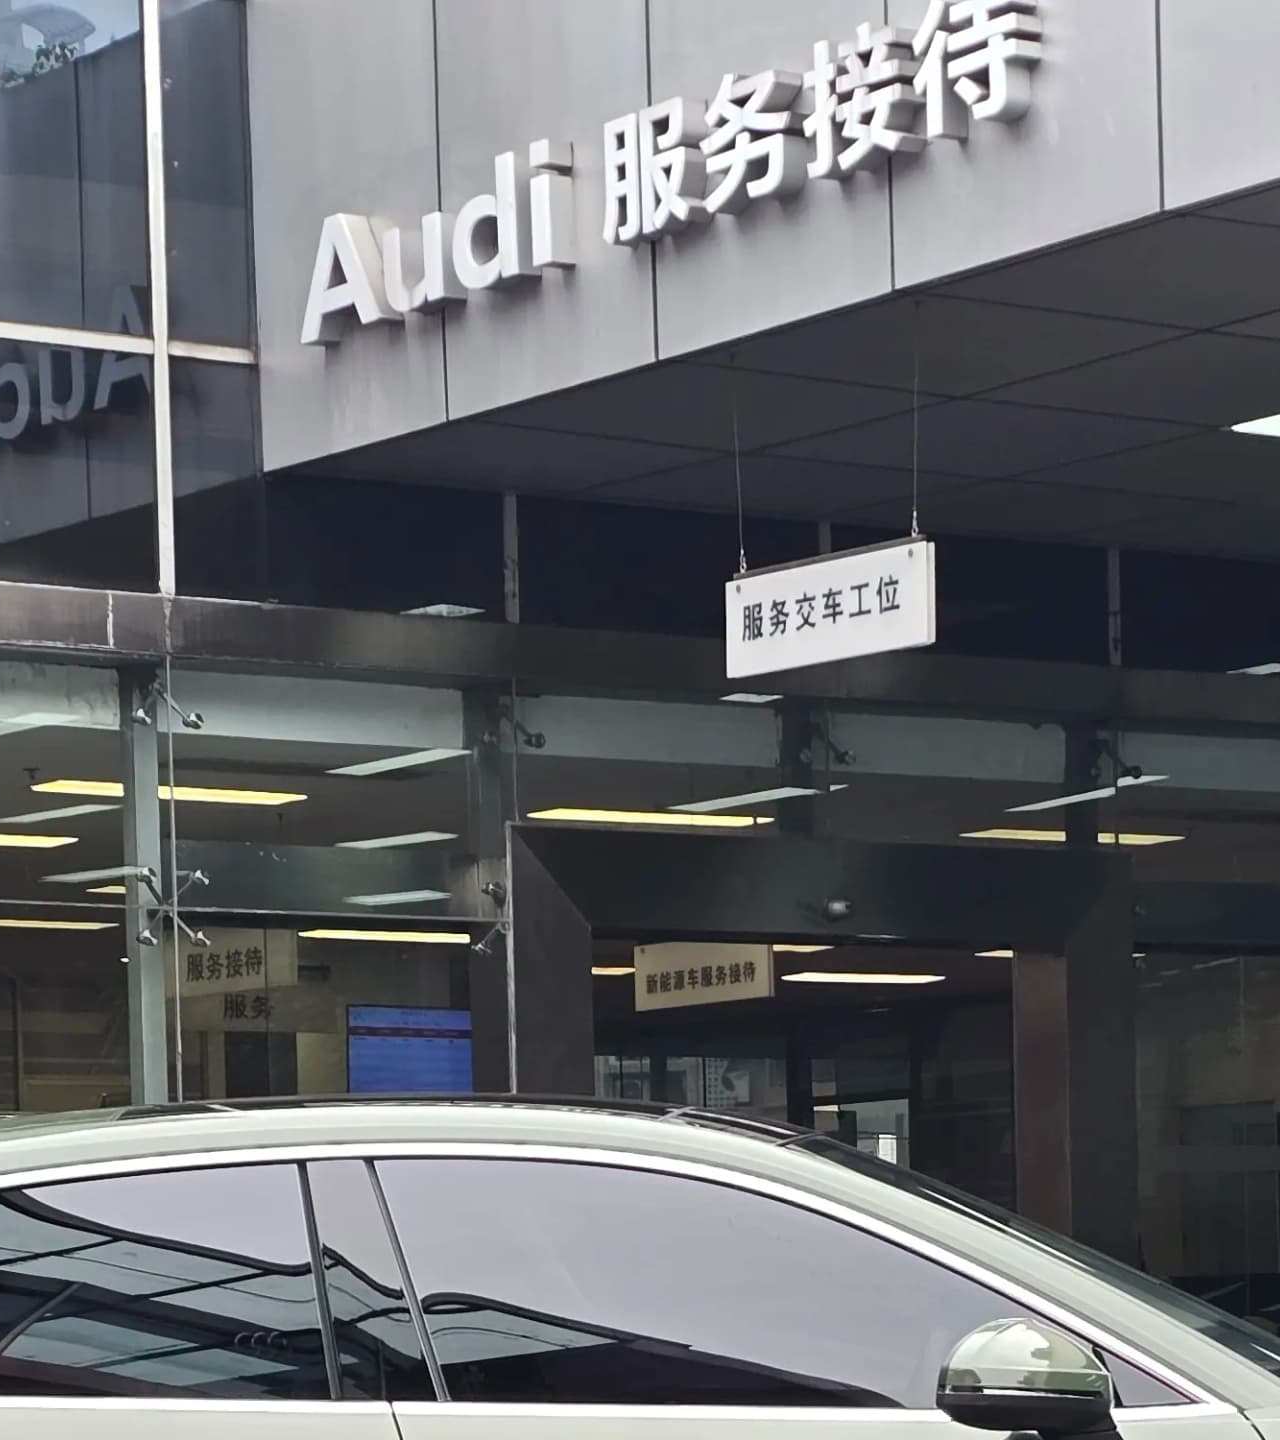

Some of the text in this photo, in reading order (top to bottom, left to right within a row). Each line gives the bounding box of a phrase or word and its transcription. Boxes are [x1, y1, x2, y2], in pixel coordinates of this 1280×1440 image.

[300, 0, 1042, 347] Audi 服务接待
[741, 574, 901, 642] 服务交车工位
[186, 946, 263, 982] 服务接待
[646, 961, 757, 994] 新能源车服务接待
